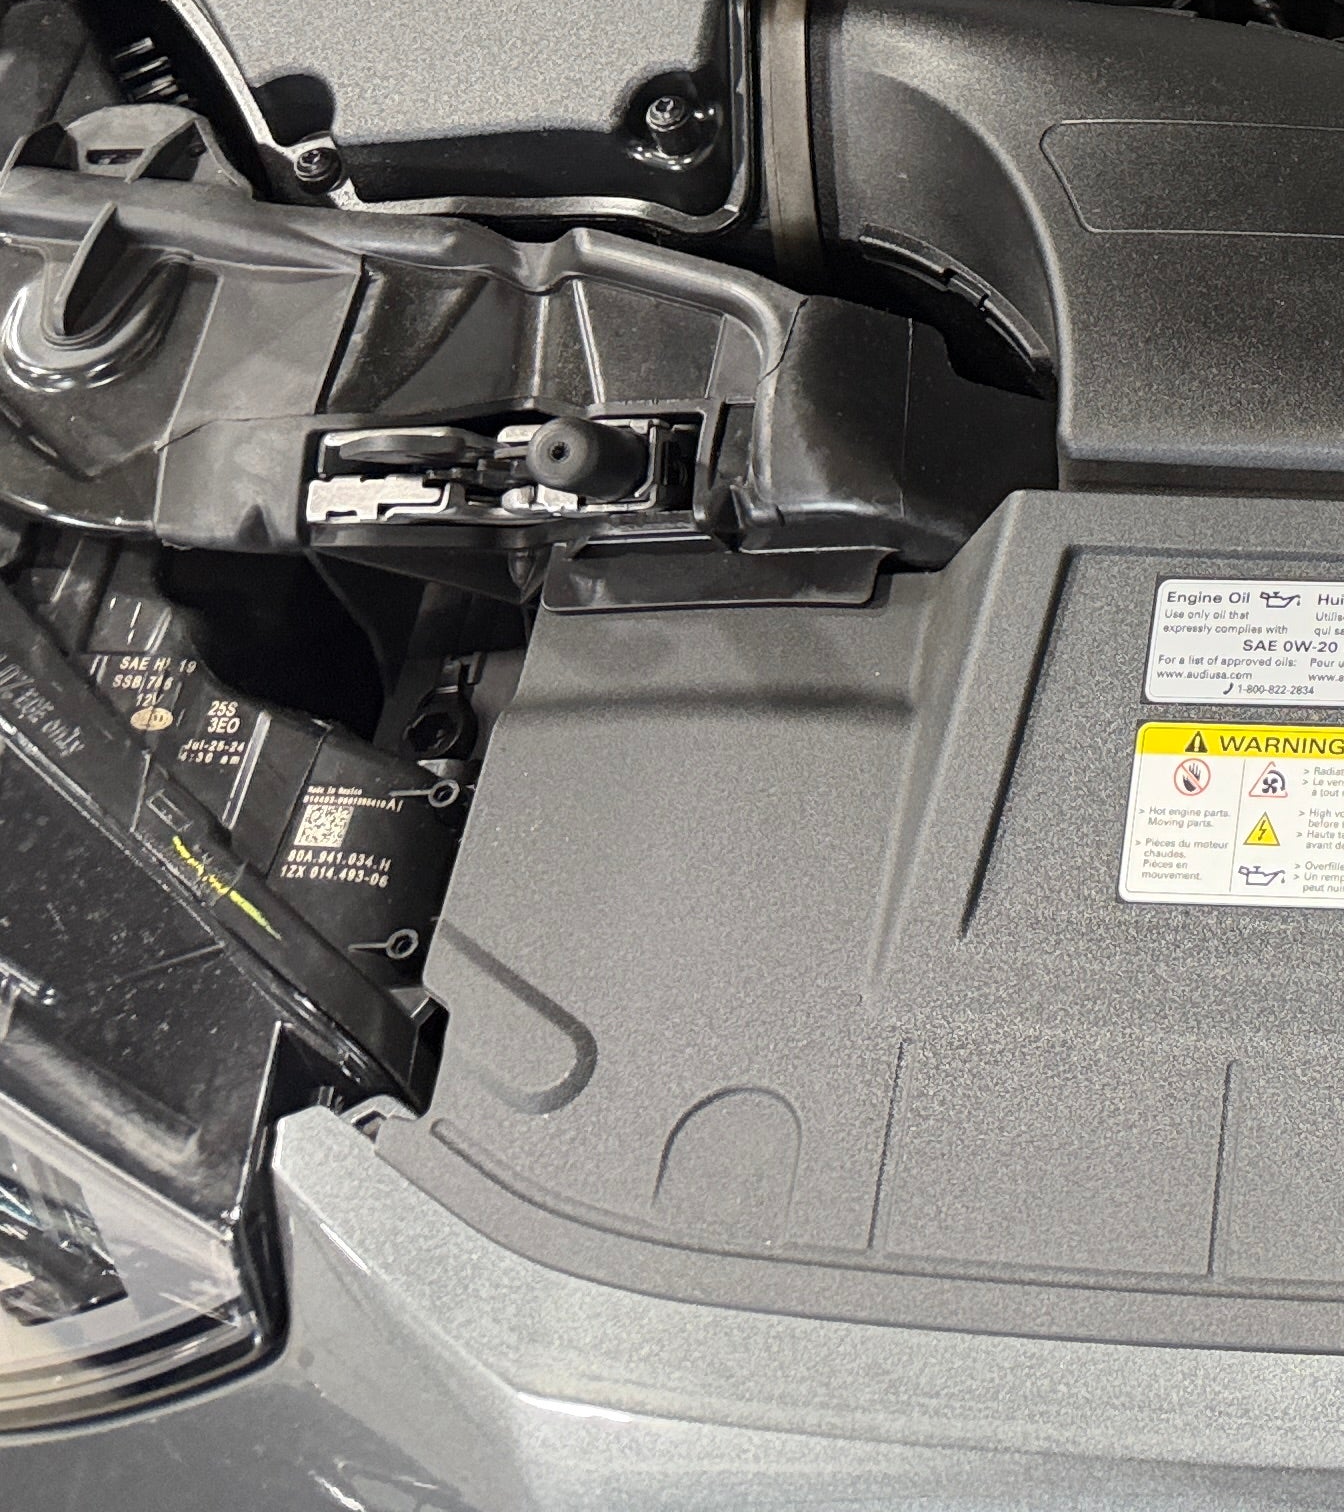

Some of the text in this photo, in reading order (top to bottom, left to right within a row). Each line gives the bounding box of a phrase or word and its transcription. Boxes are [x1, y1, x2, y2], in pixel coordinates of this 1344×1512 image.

[1167, 591, 1250, 606] Engine Oil
[1165, 609, 1249, 620] Use only oil that
[1163, 624, 1288, 635] expressly complies with
[1314, 627, 1331, 637] qui
[1242, 639, 1278, 652] SAE
[1283, 640, 1339, 653] 0W-20
[119, 657, 148, 671] SAE
[179, 660, 197, 674] 19
[1158, 654, 1175, 665] For
[1179, 657, 1185, 665] a
[1188, 654, 1204, 665] list
[1207, 655, 1218, 665] of
[1221, 656, 1272, 669] approved
[1310, 658, 1335, 667] Pour
[1156, 668, 1252, 680] www.audiusa.com
[208, 700, 239, 716] 25S
[1169, 808, 1201, 817] engine
[1309, 808, 1332, 819] High
[1308, 818, 1339, 829] before
[1306, 829, 1335, 839] Haute
[1304, 872, 1318, 882] Un
